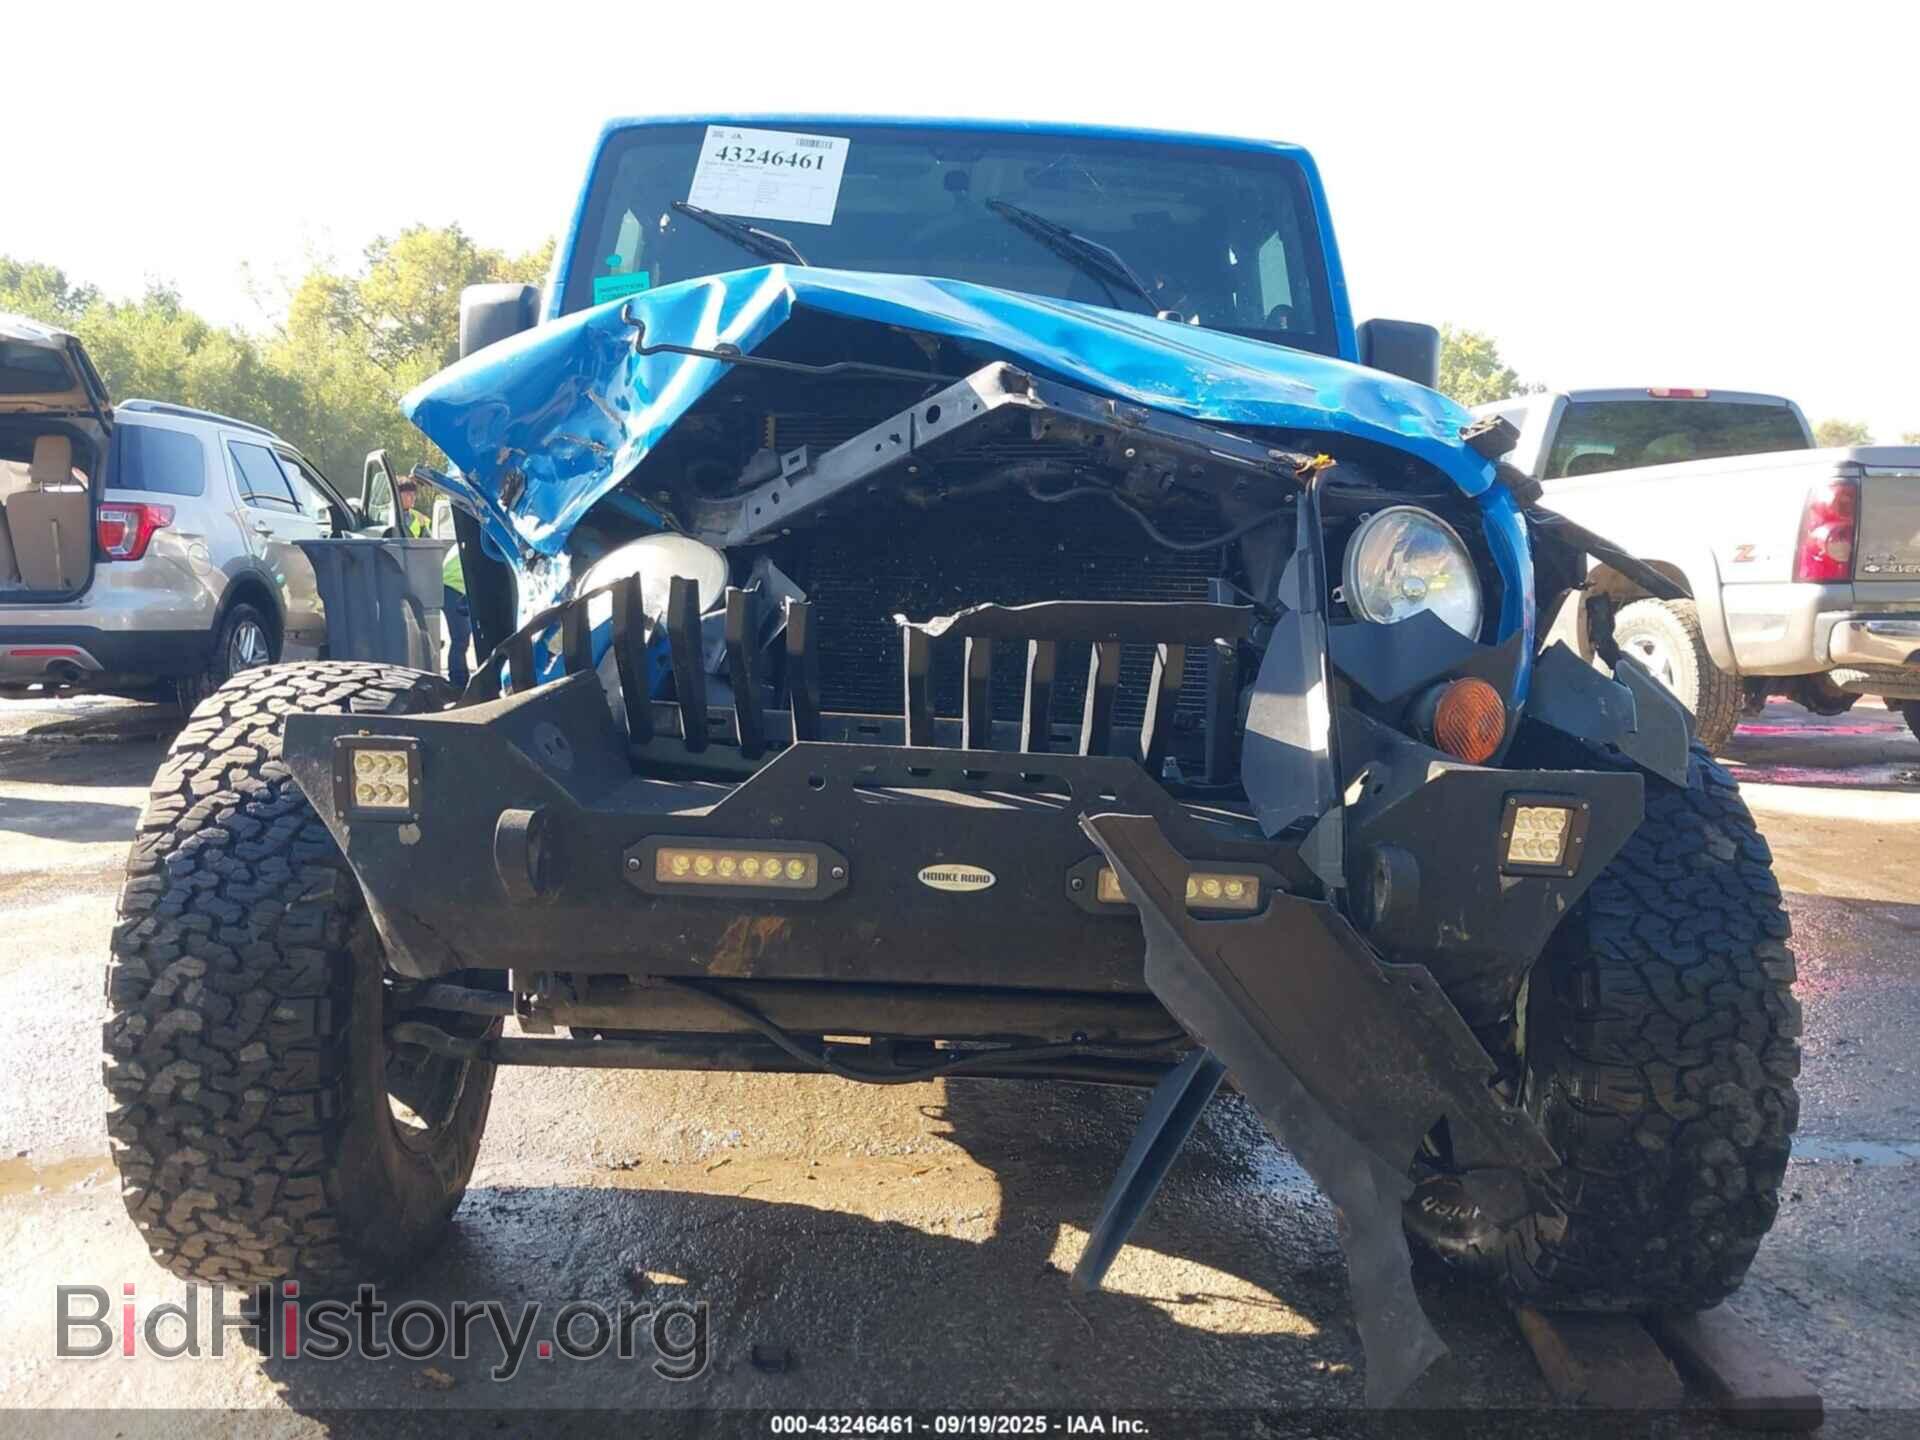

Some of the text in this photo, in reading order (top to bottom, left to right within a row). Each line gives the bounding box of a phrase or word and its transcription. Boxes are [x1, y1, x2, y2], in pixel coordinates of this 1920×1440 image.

[715, 145, 825, 170] 43246461
[922, 871, 991, 884] HOOKE ROAD
